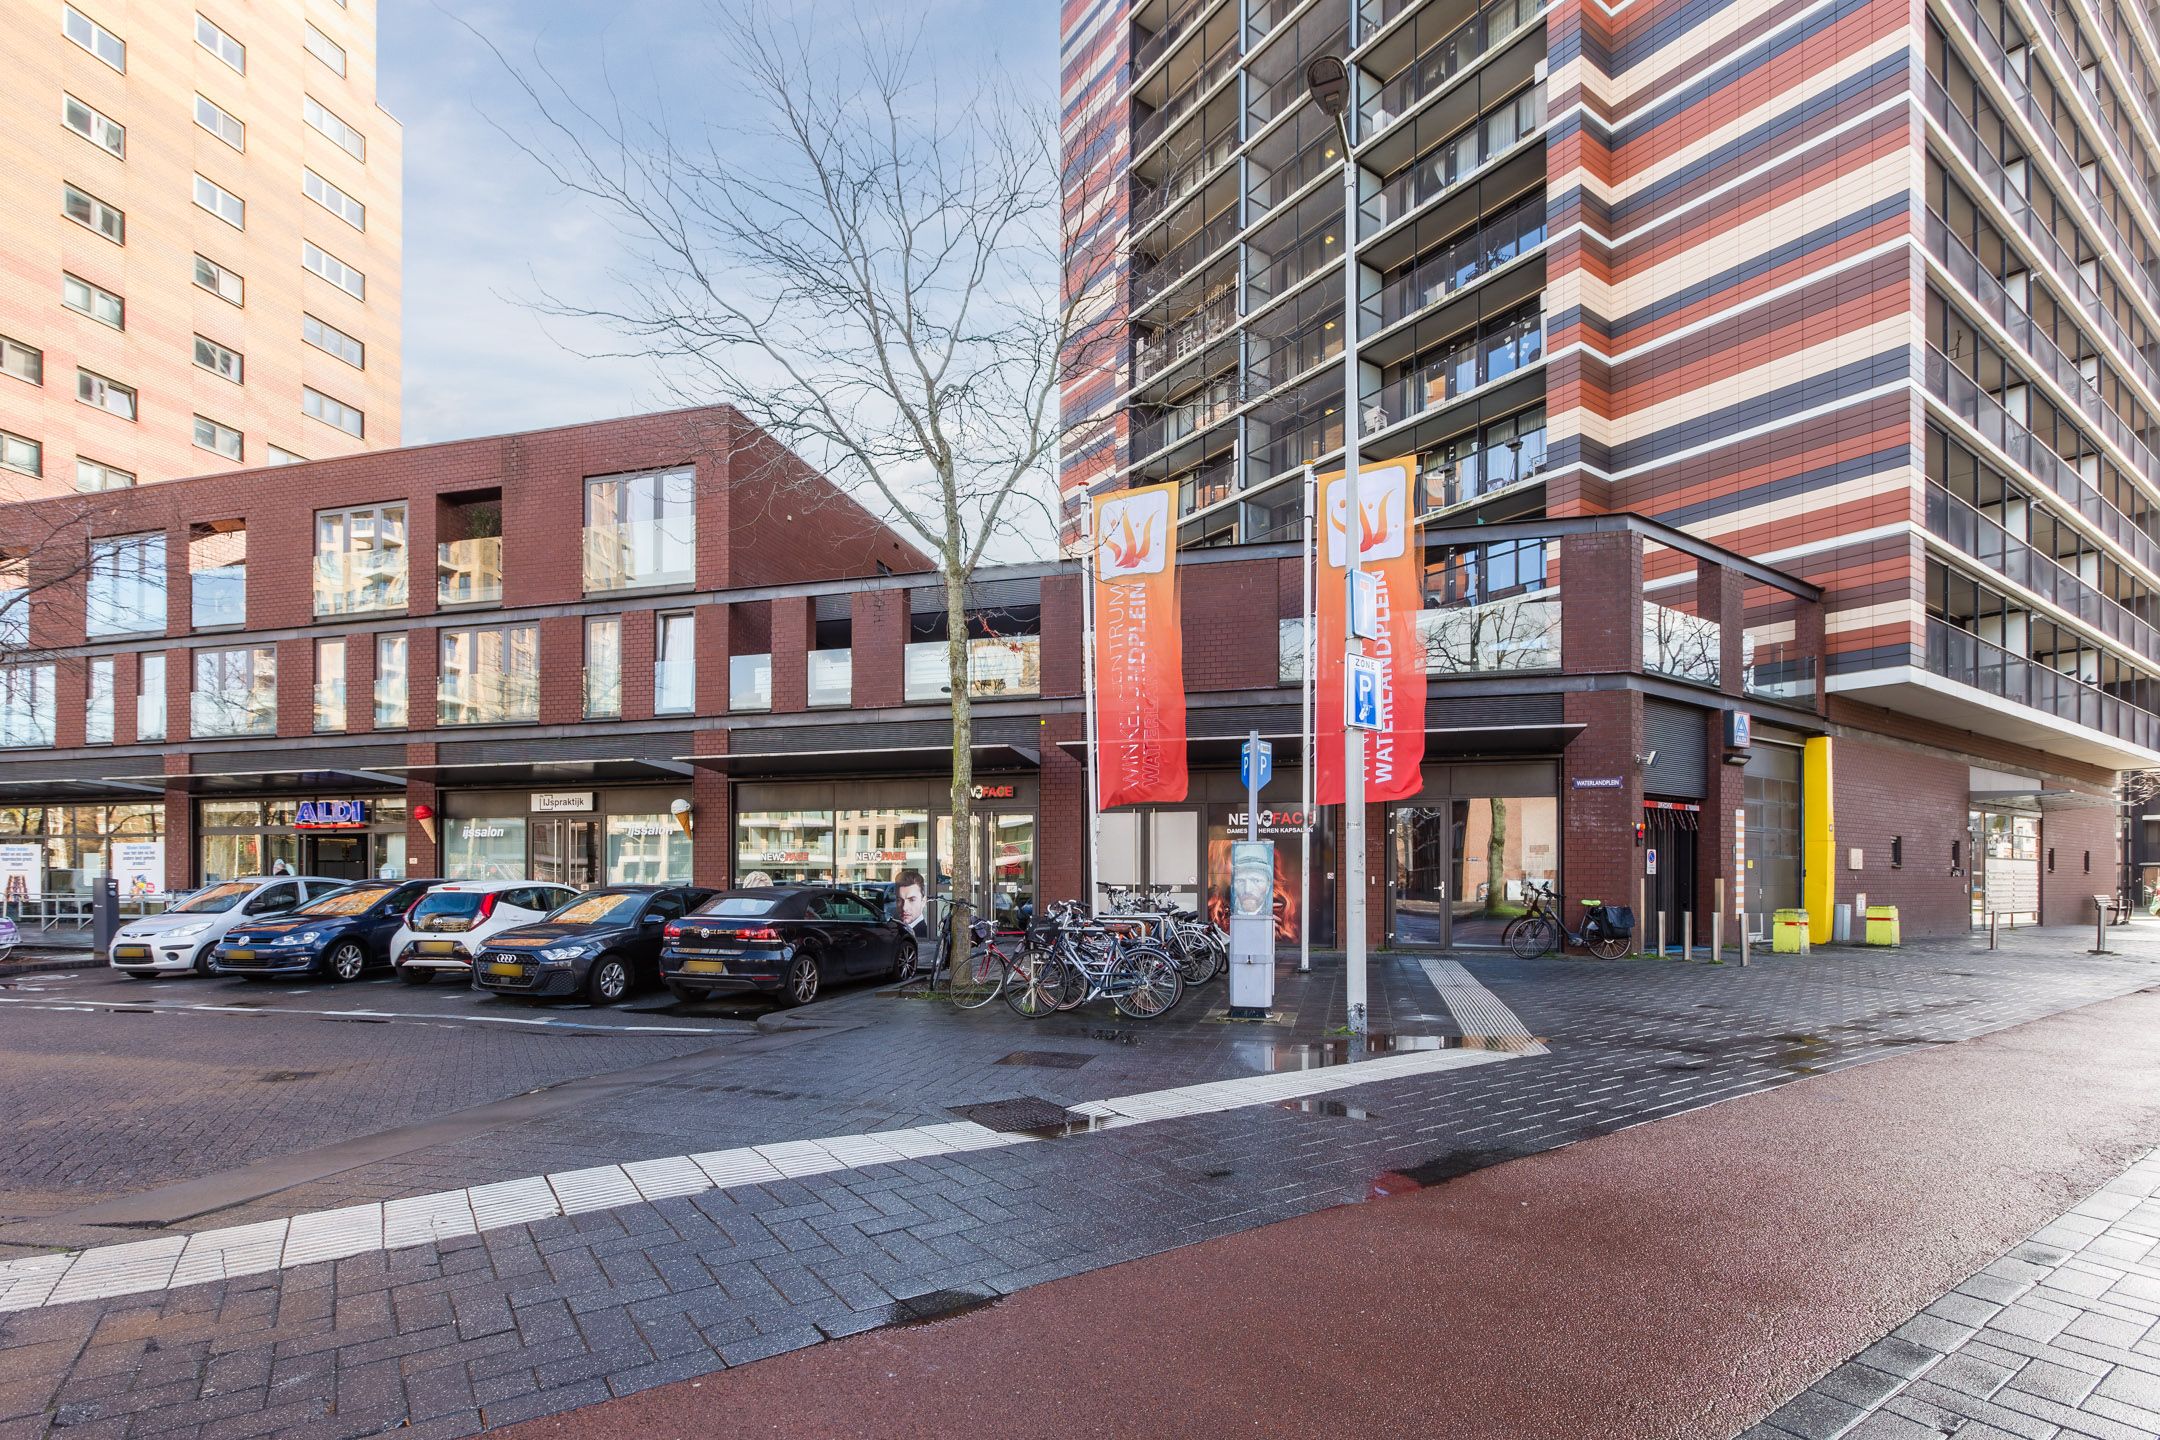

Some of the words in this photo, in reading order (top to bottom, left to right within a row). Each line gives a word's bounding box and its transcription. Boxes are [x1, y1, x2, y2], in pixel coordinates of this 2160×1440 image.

[1355, 658, 1375, 671] ZONE
[1371, 569, 1393, 784] WATERLANDPLEIN
[1359, 675, 1372, 701] P
[1243, 756, 1249, 777] P
[1260, 755, 1267, 776] P
[981, 786, 1013, 798] FACE
[543, 797, 584, 808] IJspraktijk
[294, 800, 365, 823] ALDI
[462, 826, 504, 839] ijssalon
[626, 825, 674, 838] ijssalon
[760, 852, 781, 862] NEW
[856, 852, 877, 861] NEW
